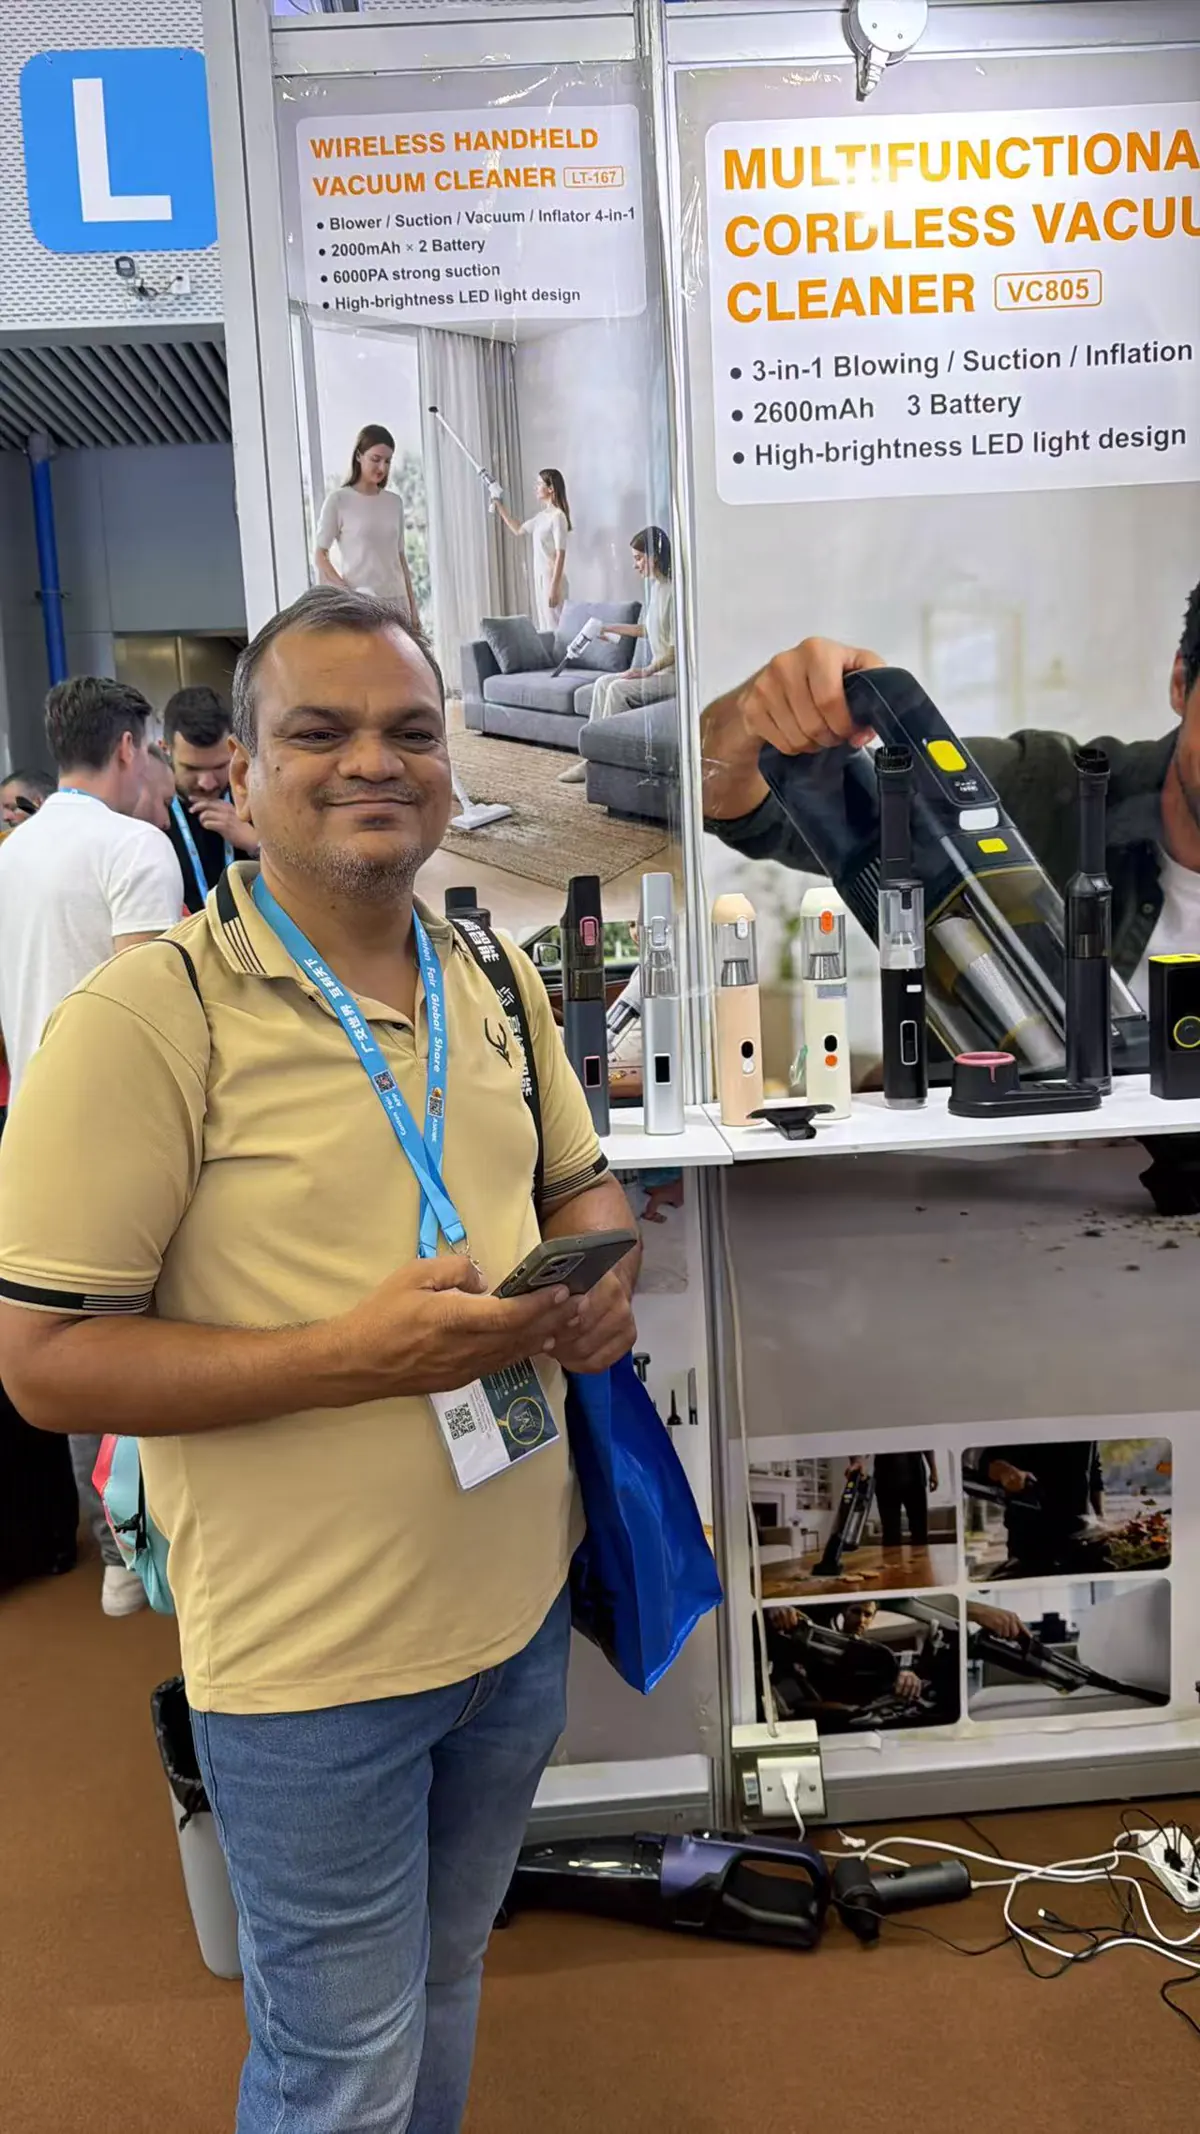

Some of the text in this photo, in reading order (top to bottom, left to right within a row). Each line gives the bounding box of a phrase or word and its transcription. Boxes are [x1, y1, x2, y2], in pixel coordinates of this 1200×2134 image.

[72, 78, 172, 222] L
[309, 127, 599, 160] WIRELESS HANDHELD
[313, 166, 615, 197] VACUUM CLEANER LT-167
[329, 217, 382, 231] Blower
[395, 213, 452, 228] Suction
[464, 211, 525, 224] Vacuum
[538, 209, 591, 223] Inflator
[595, 206, 635, 222] 4-in-1
[724, 204, 1016, 259] CORDLESS
[331, 241, 401, 257] 2000mAh
[418, 239, 428, 253] 2
[432, 239, 486, 254] Battery
[333, 264, 500, 284] 6000PA strong suction
[335, 288, 580, 313] High-brightness LED light design
[726, 272, 1089, 324] CLEANER VC805
[753, 357, 821, 382] 3-in-1
[834, 352, 939, 379] Blowing
[963, 348, 1061, 372] Suction
[1086, 340, 1192, 366] Inflation
[754, 393, 1022, 424] 2600mAh 3 Battery
[755, 425, 1186, 471] High-brightness LED light design
[426, 966, 436, 988] Fair
[430, 993, 443, 1032] Global
[433, 1036, 443, 1073] Share
